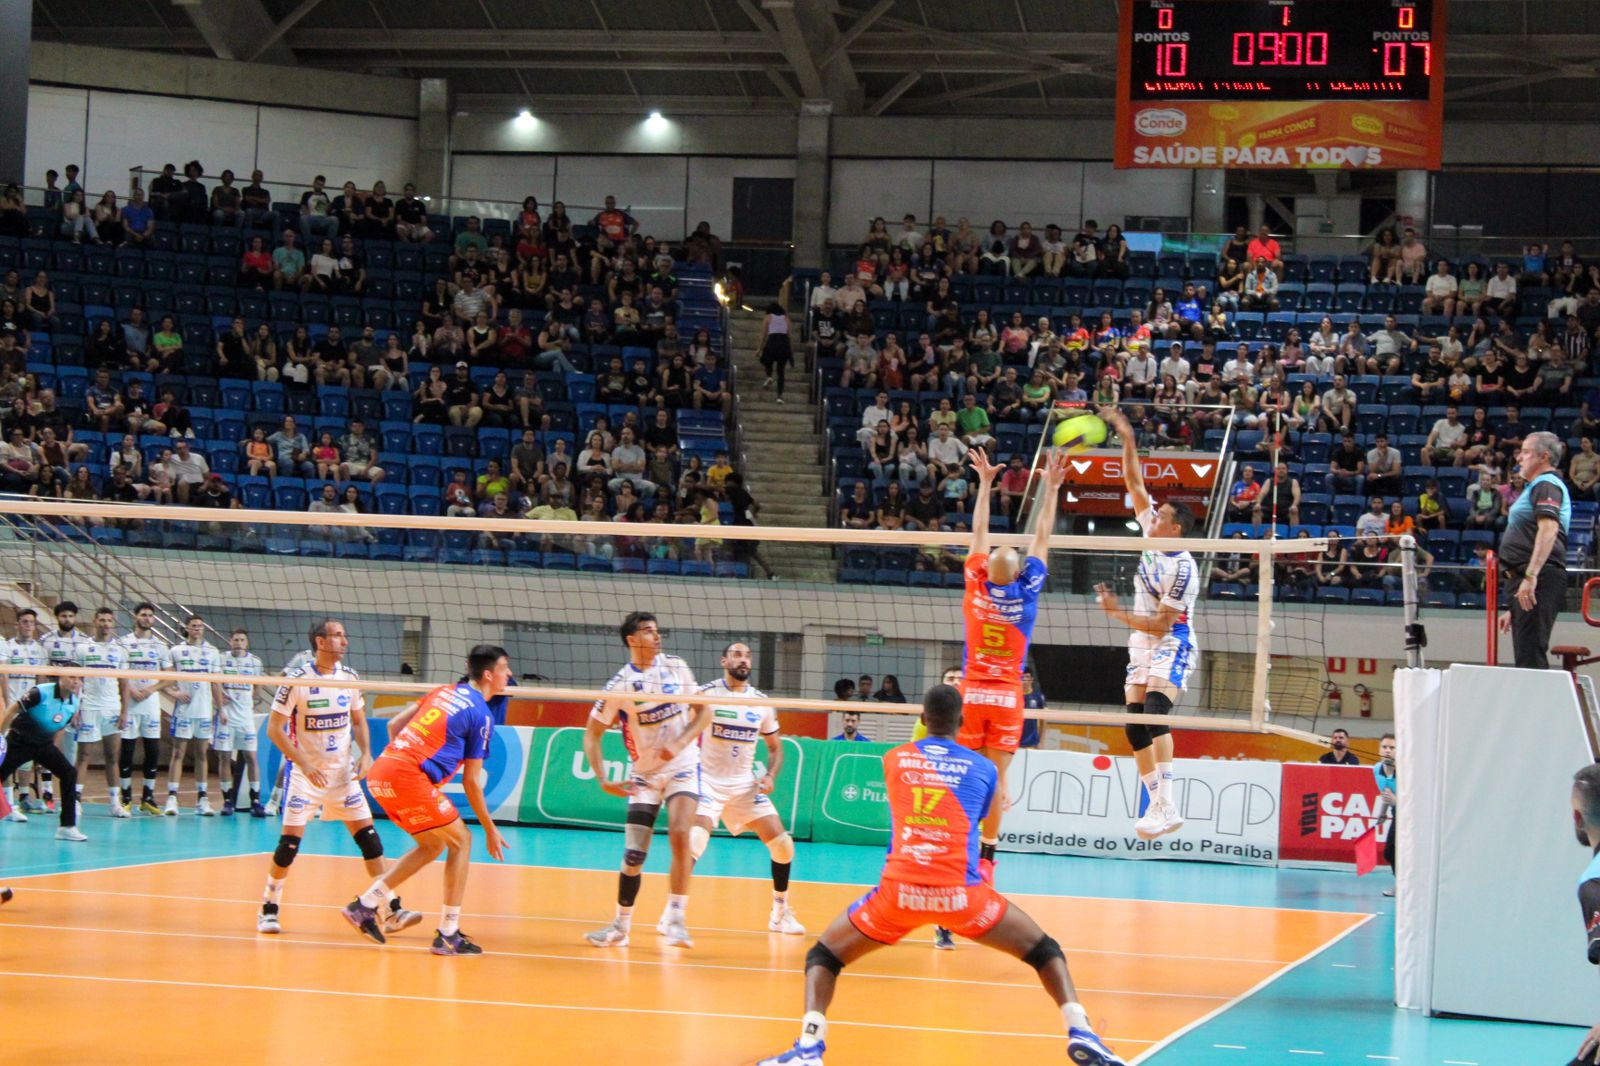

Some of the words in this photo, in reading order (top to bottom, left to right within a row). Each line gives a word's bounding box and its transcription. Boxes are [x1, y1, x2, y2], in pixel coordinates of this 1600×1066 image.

[1158, 9, 1172, 29] 0
[1399, 8, 1413, 28] 0
[1134, 32, 1190, 42] PONTOS
[1373, 31, 1429, 41] PONTOS
[1232, 32, 1328, 65] 09:00
[1156, 43, 1187, 76] 10
[1384, 42, 1431, 76] 07
[1139, 117, 1183, 128] Conde
[1133, 142, 1217, 164] SAÚDE
[1223, 146, 1290, 164] PARA
[1295, 146, 1382, 167] TODS
[1103, 460, 1178, 480] SÍDA
[1169, 558, 1191, 598] Renata
[983, 624, 1006, 648] 5
[419, 708, 441, 725] 9
[328, 735, 335, 747] 8
[714, 724, 756, 740] Renata
[731, 746, 740, 757] 5
[898, 758, 968, 775] MILCLEAN
[911, 787, 946, 815] 17
[997, 832, 1088, 848] versidade
[1093, 837, 1118, 851] do
[1124, 837, 1163, 852] Vale
[1169, 838, 1194, 852] do
